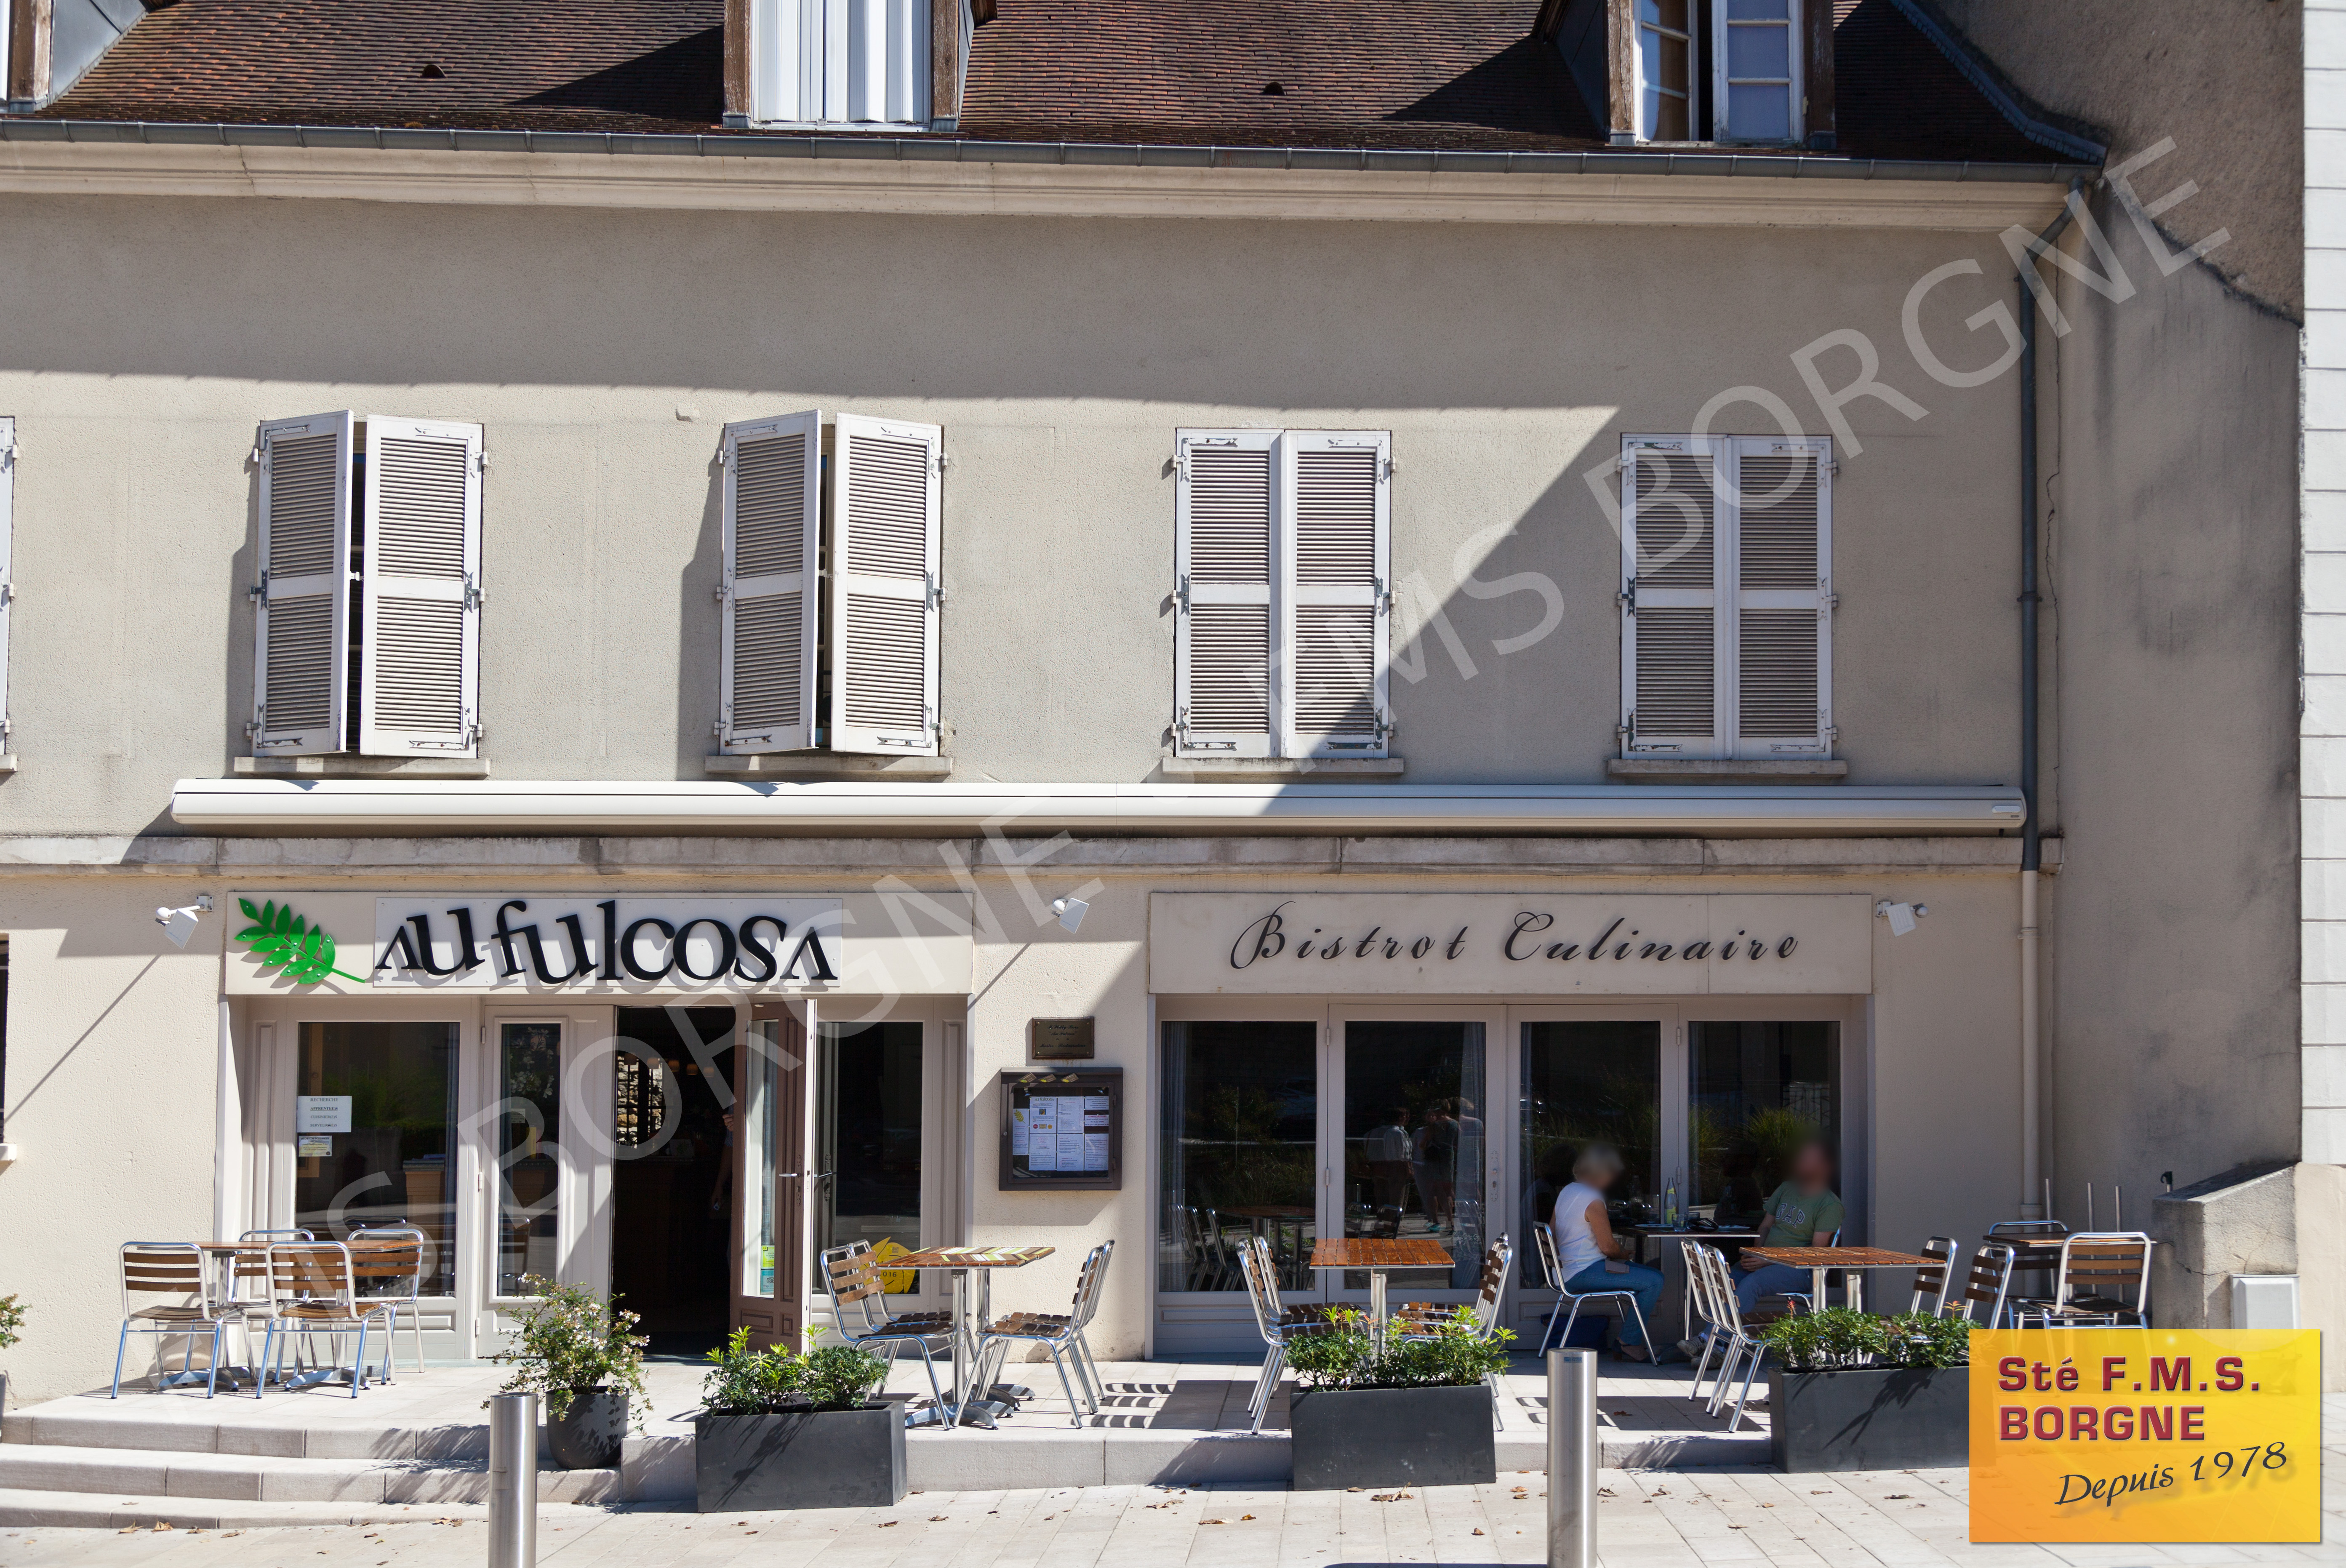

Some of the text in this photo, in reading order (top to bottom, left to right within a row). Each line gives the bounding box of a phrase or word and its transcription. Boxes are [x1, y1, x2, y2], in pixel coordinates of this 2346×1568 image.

[1230, 901, 1798, 969] Bistrot Culinaire
[1775, 1203, 1805, 1228] GAP
